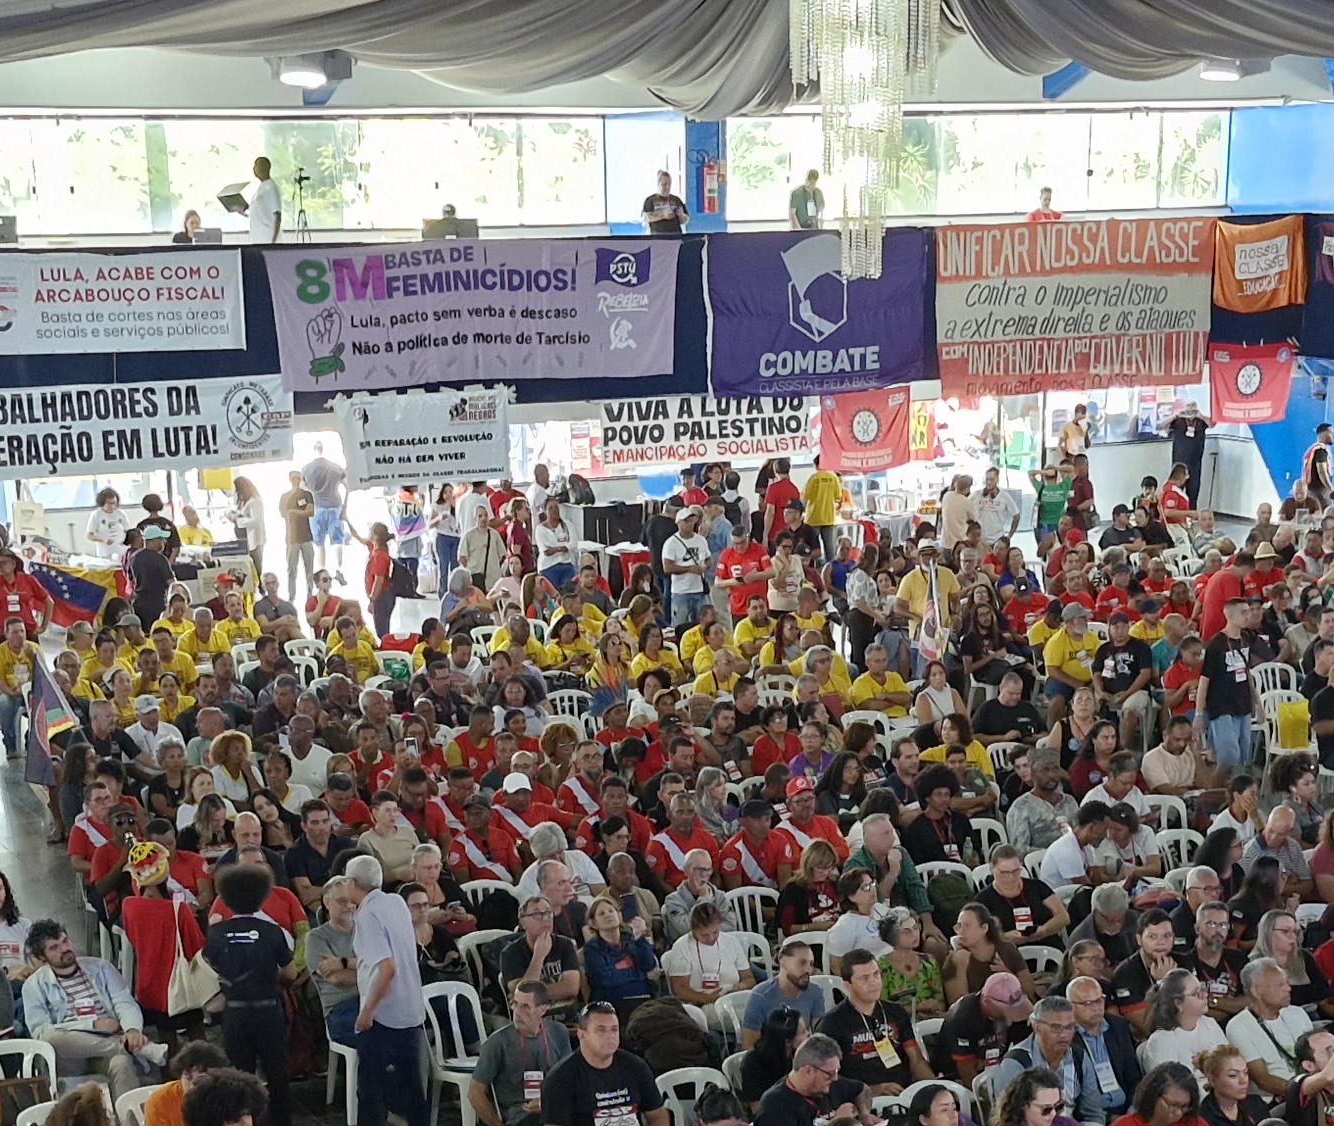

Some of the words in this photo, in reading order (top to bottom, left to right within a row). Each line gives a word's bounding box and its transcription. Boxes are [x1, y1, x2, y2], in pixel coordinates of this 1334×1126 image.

[383, 248, 448, 271] BASTA
[449, 245, 475, 263] DE
[937, 227, 1031, 278] UNIFICAR
[1036, 221, 1111, 272] NOSSA
[1117, 220, 1204, 264] CLASSE
[1238, 242, 1279, 260] nossa
[39, 267, 90, 285] LULA,
[95, 266, 156, 281] ACABE
[160, 265, 202, 281] COM
[206, 265, 221, 280] O
[1238, 253, 1286, 276] CLASSE
[295, 254, 388, 305] 8M
[385, 262, 578, 299] FEMINICÍDIOS!
[33, 287, 151, 307] ARCABOUÇO
[155, 285, 225, 301] FISCAL!
[1034, 284, 1048, 307] o
[1052, 277, 1168, 312] imperialismo
[40, 309, 82, 324] Basta
[85, 309, 105, 324] de
[107, 309, 154, 323] cortes
[156, 310, 183, 321] nas
[185, 307, 227, 321] áreas
[350, 314, 386, 329] Lula,
[389, 310, 429, 329] pacto
[432, 308, 462, 322] sem
[466, 304, 506, 319] verba
[508, 304, 517, 319] é
[520, 306, 578, 320] descaso
[944, 319, 958, 341] a
[959, 309, 1037, 340] extrema
[1038, 307, 1094, 336] direita
[1098, 312, 1111, 332] e
[1115, 310, 1133, 332] os
[1135, 305, 1195, 333] ataques
[35, 325, 89, 340] sociais
[91, 327, 101, 338] e
[103, 324, 165, 340] serviços
[166, 321, 230, 338] públicos!
[351, 340, 381, 357] Não
[383, 342, 395, 354] a
[397, 332, 449, 355] política
[451, 331, 469, 346] de
[472, 331, 512, 345] morte
[514, 331, 533, 345] de
[536, 330, 591, 345] Tarcísio
[758, 345, 881, 378] COMBATE
[941, 345, 969, 360] COM
[968, 337, 1077, 377] INDEPENDENCIA
[1074, 338, 1090, 353] DO
[1088, 332, 1166, 376] GOVERNO
[1170, 329, 1206, 377] LULA
[759, 379, 813, 394] CLASSISTA
[823, 378, 851, 390] PELA
[852, 374, 880, 388] BASE
[166, 385, 201, 417] DA
[602, 399, 670, 423] VIVA
[676, 397, 694, 420] A
[700, 395, 766, 418] LUTA
[771, 396, 805, 414] DO
[100, 426, 143, 463] EM
[150, 423, 220, 458] LUTA!
[602, 423, 665, 448] POVO
[673, 413, 810, 443] PALESTINO!
[603, 442, 708, 464] EMANCIPAÇÃO
[716, 435, 810, 457] SOCIALISTA
